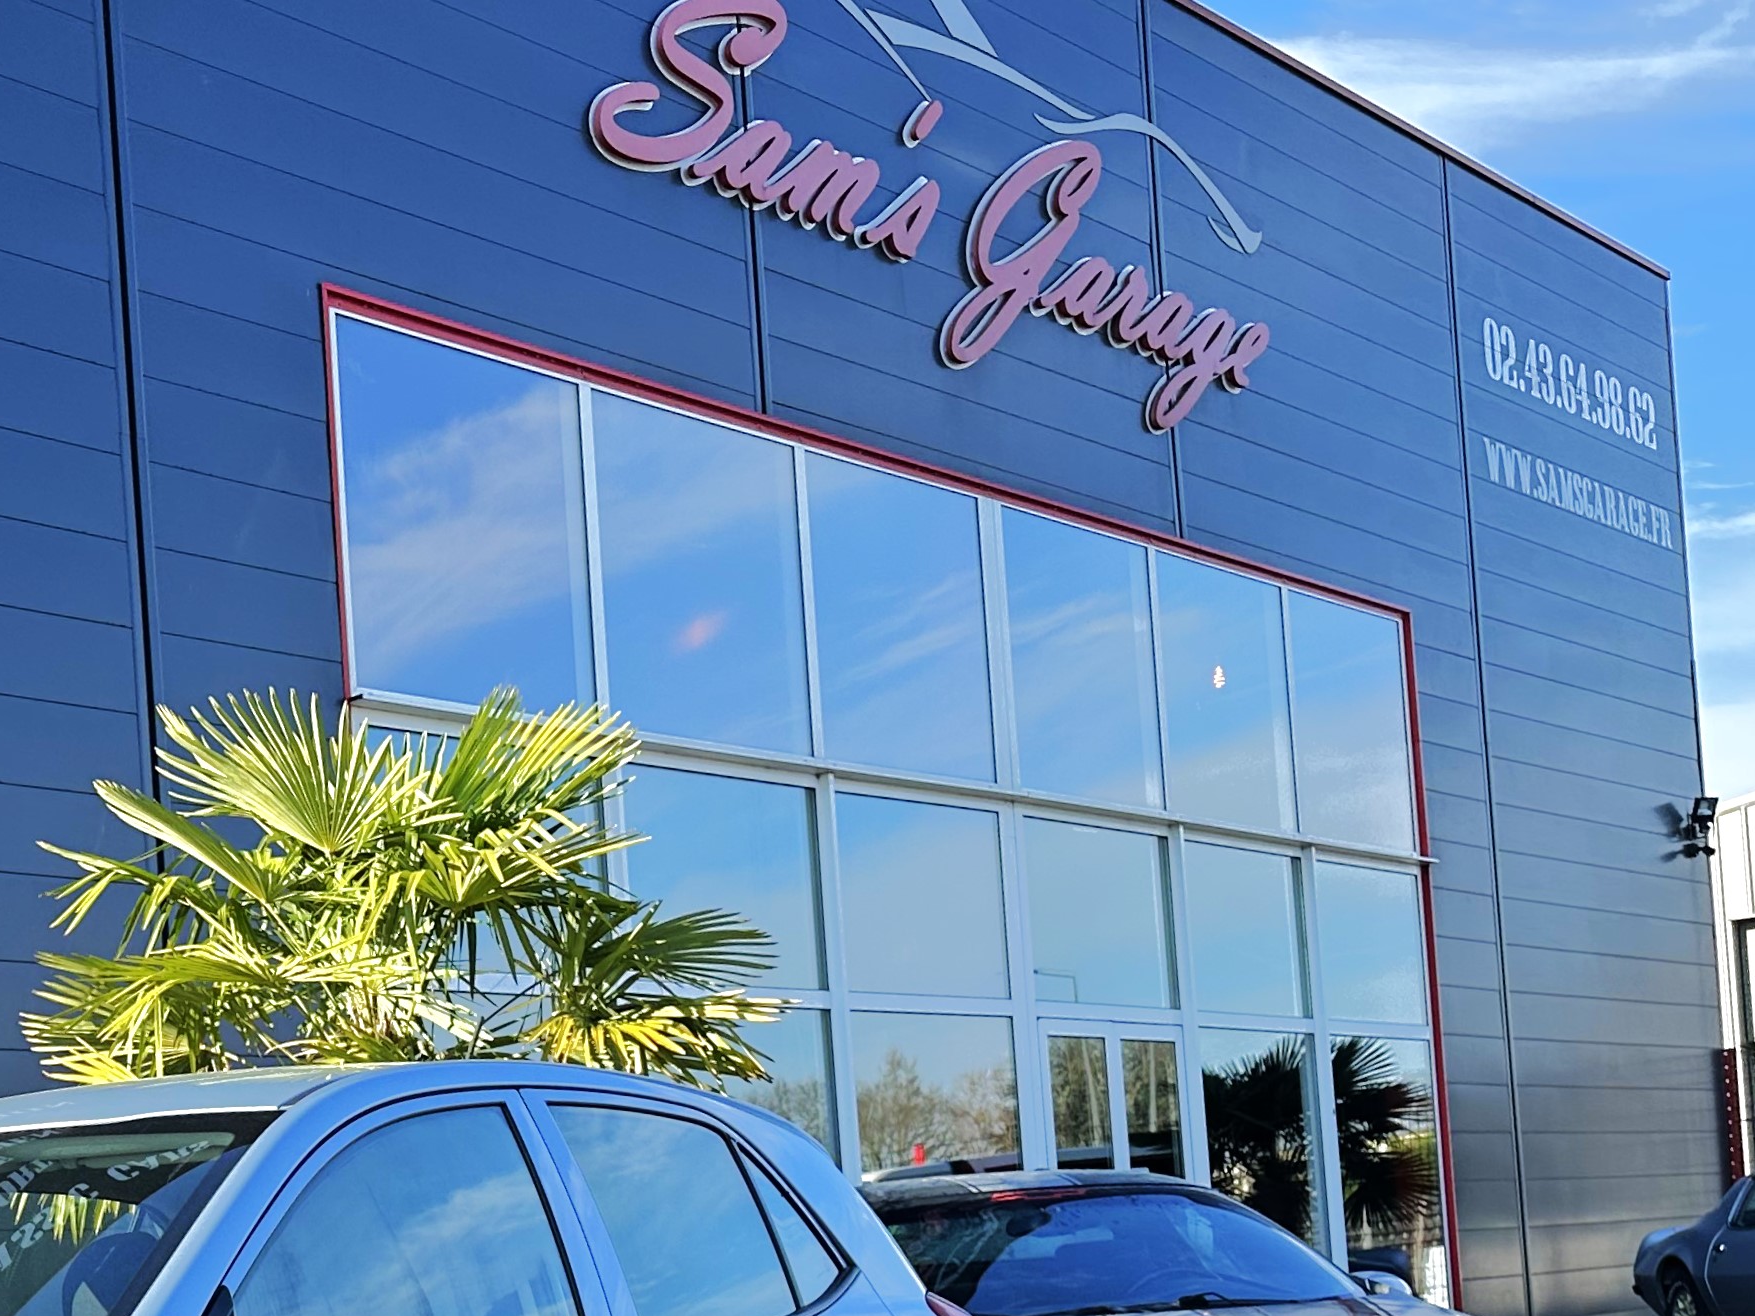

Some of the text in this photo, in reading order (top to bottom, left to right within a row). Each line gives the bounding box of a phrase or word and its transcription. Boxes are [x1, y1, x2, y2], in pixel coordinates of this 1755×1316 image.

[588, 0, 1270, 434] Sam's Garage
[1483, 317, 1657, 450] 02.43.64.98.62
[1482, 436, 1673, 550] WWW.SAMSGARAGE.FR
